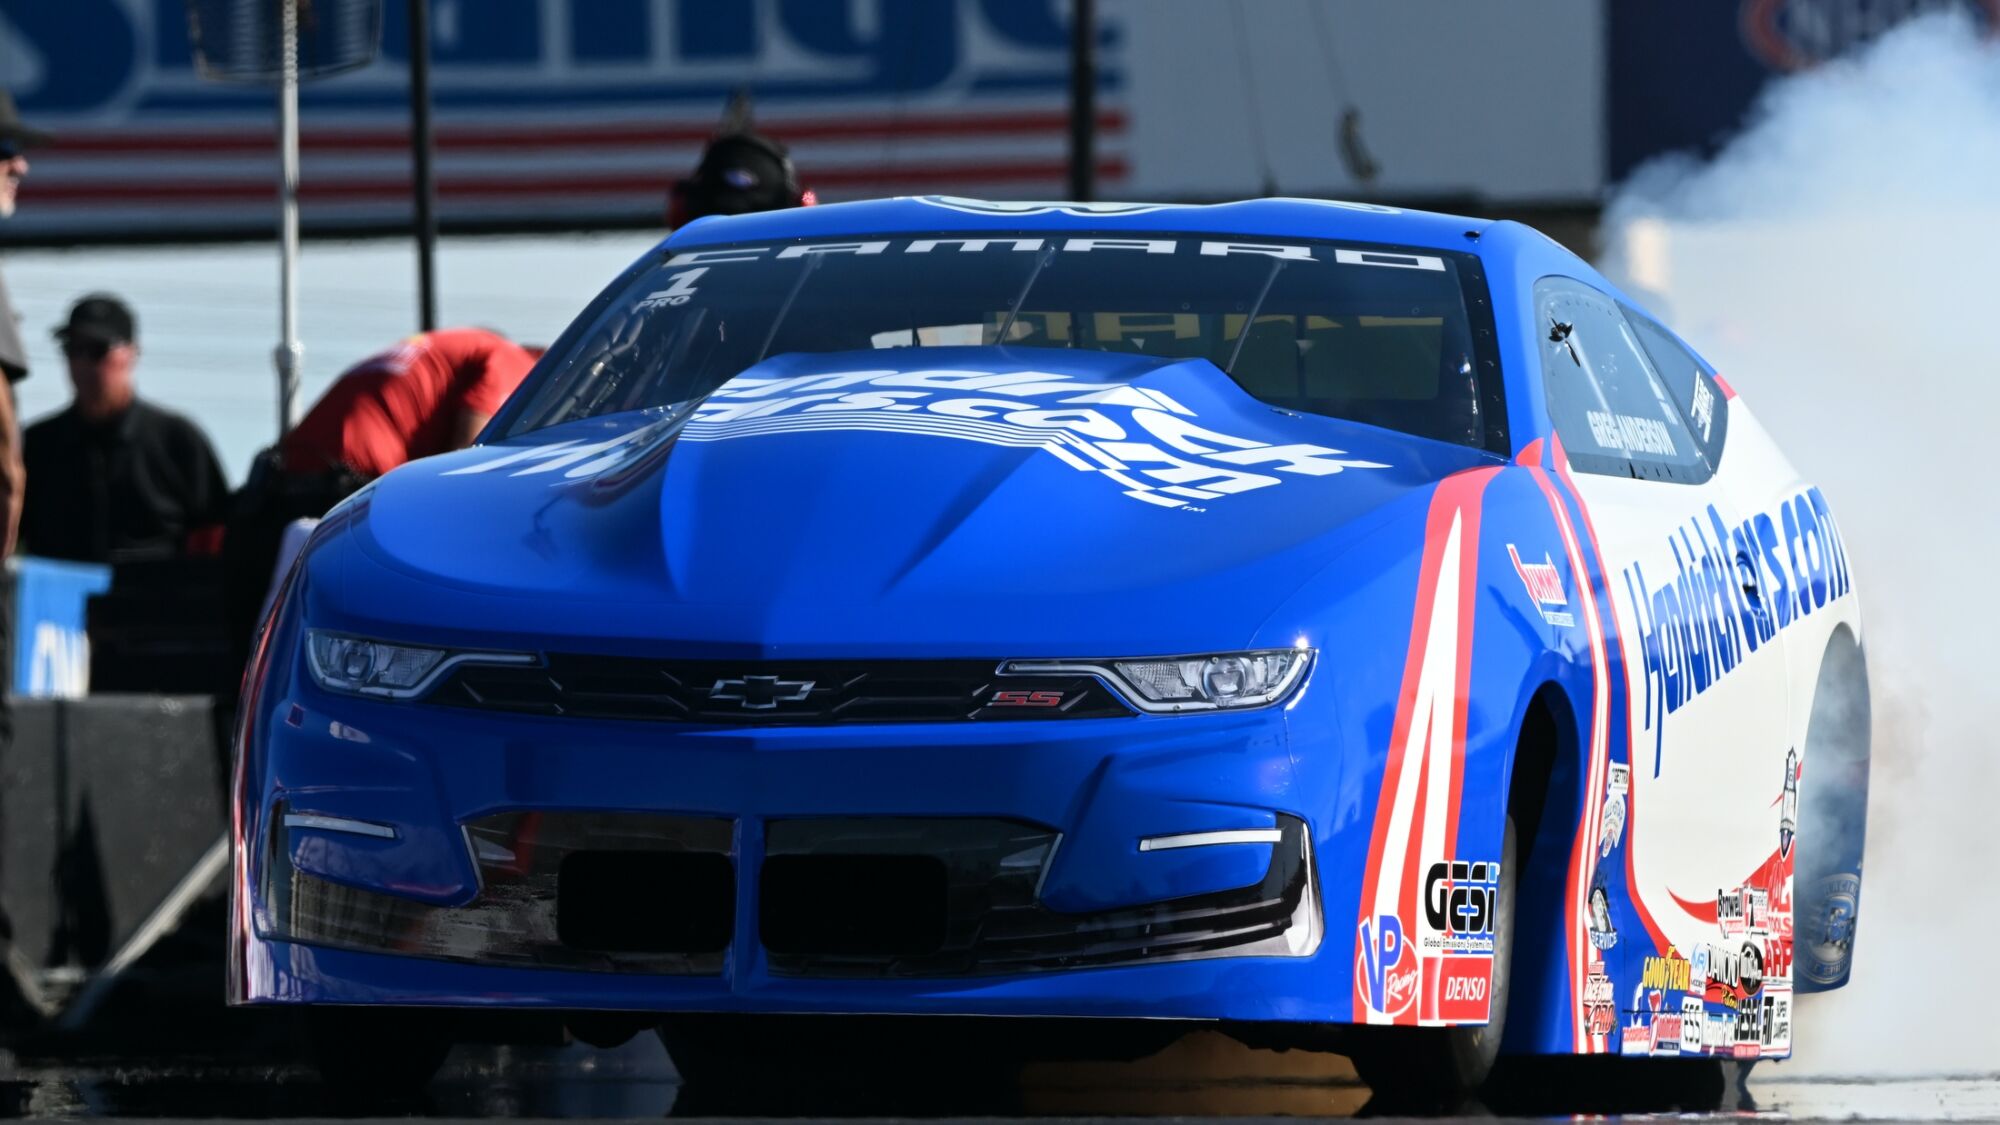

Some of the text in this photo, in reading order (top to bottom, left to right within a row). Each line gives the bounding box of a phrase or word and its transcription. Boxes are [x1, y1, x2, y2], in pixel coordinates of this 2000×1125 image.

[662, 239, 1446, 272] CAMARO
[646, 267, 710, 300] 1
[632, 295, 690, 314] PRO
[1587, 410, 1625, 449] GREG
[1616, 414, 1677, 457] ANDERSON
[987, 691, 1064, 706] SS
[1718, 889, 1743, 917] Browell
[1424, 937, 1442, 948] Global
[1467, 937, 1485, 951] Systems
[1589, 930, 1617, 949] SERVICE
[1359, 914, 1403, 1013] VP
[1764, 939, 1792, 977] ARP
[1387, 968, 1418, 1004] Racing
[1445, 977, 1486, 1000] DENSO
[1591, 1003, 1614, 1034] PRO
